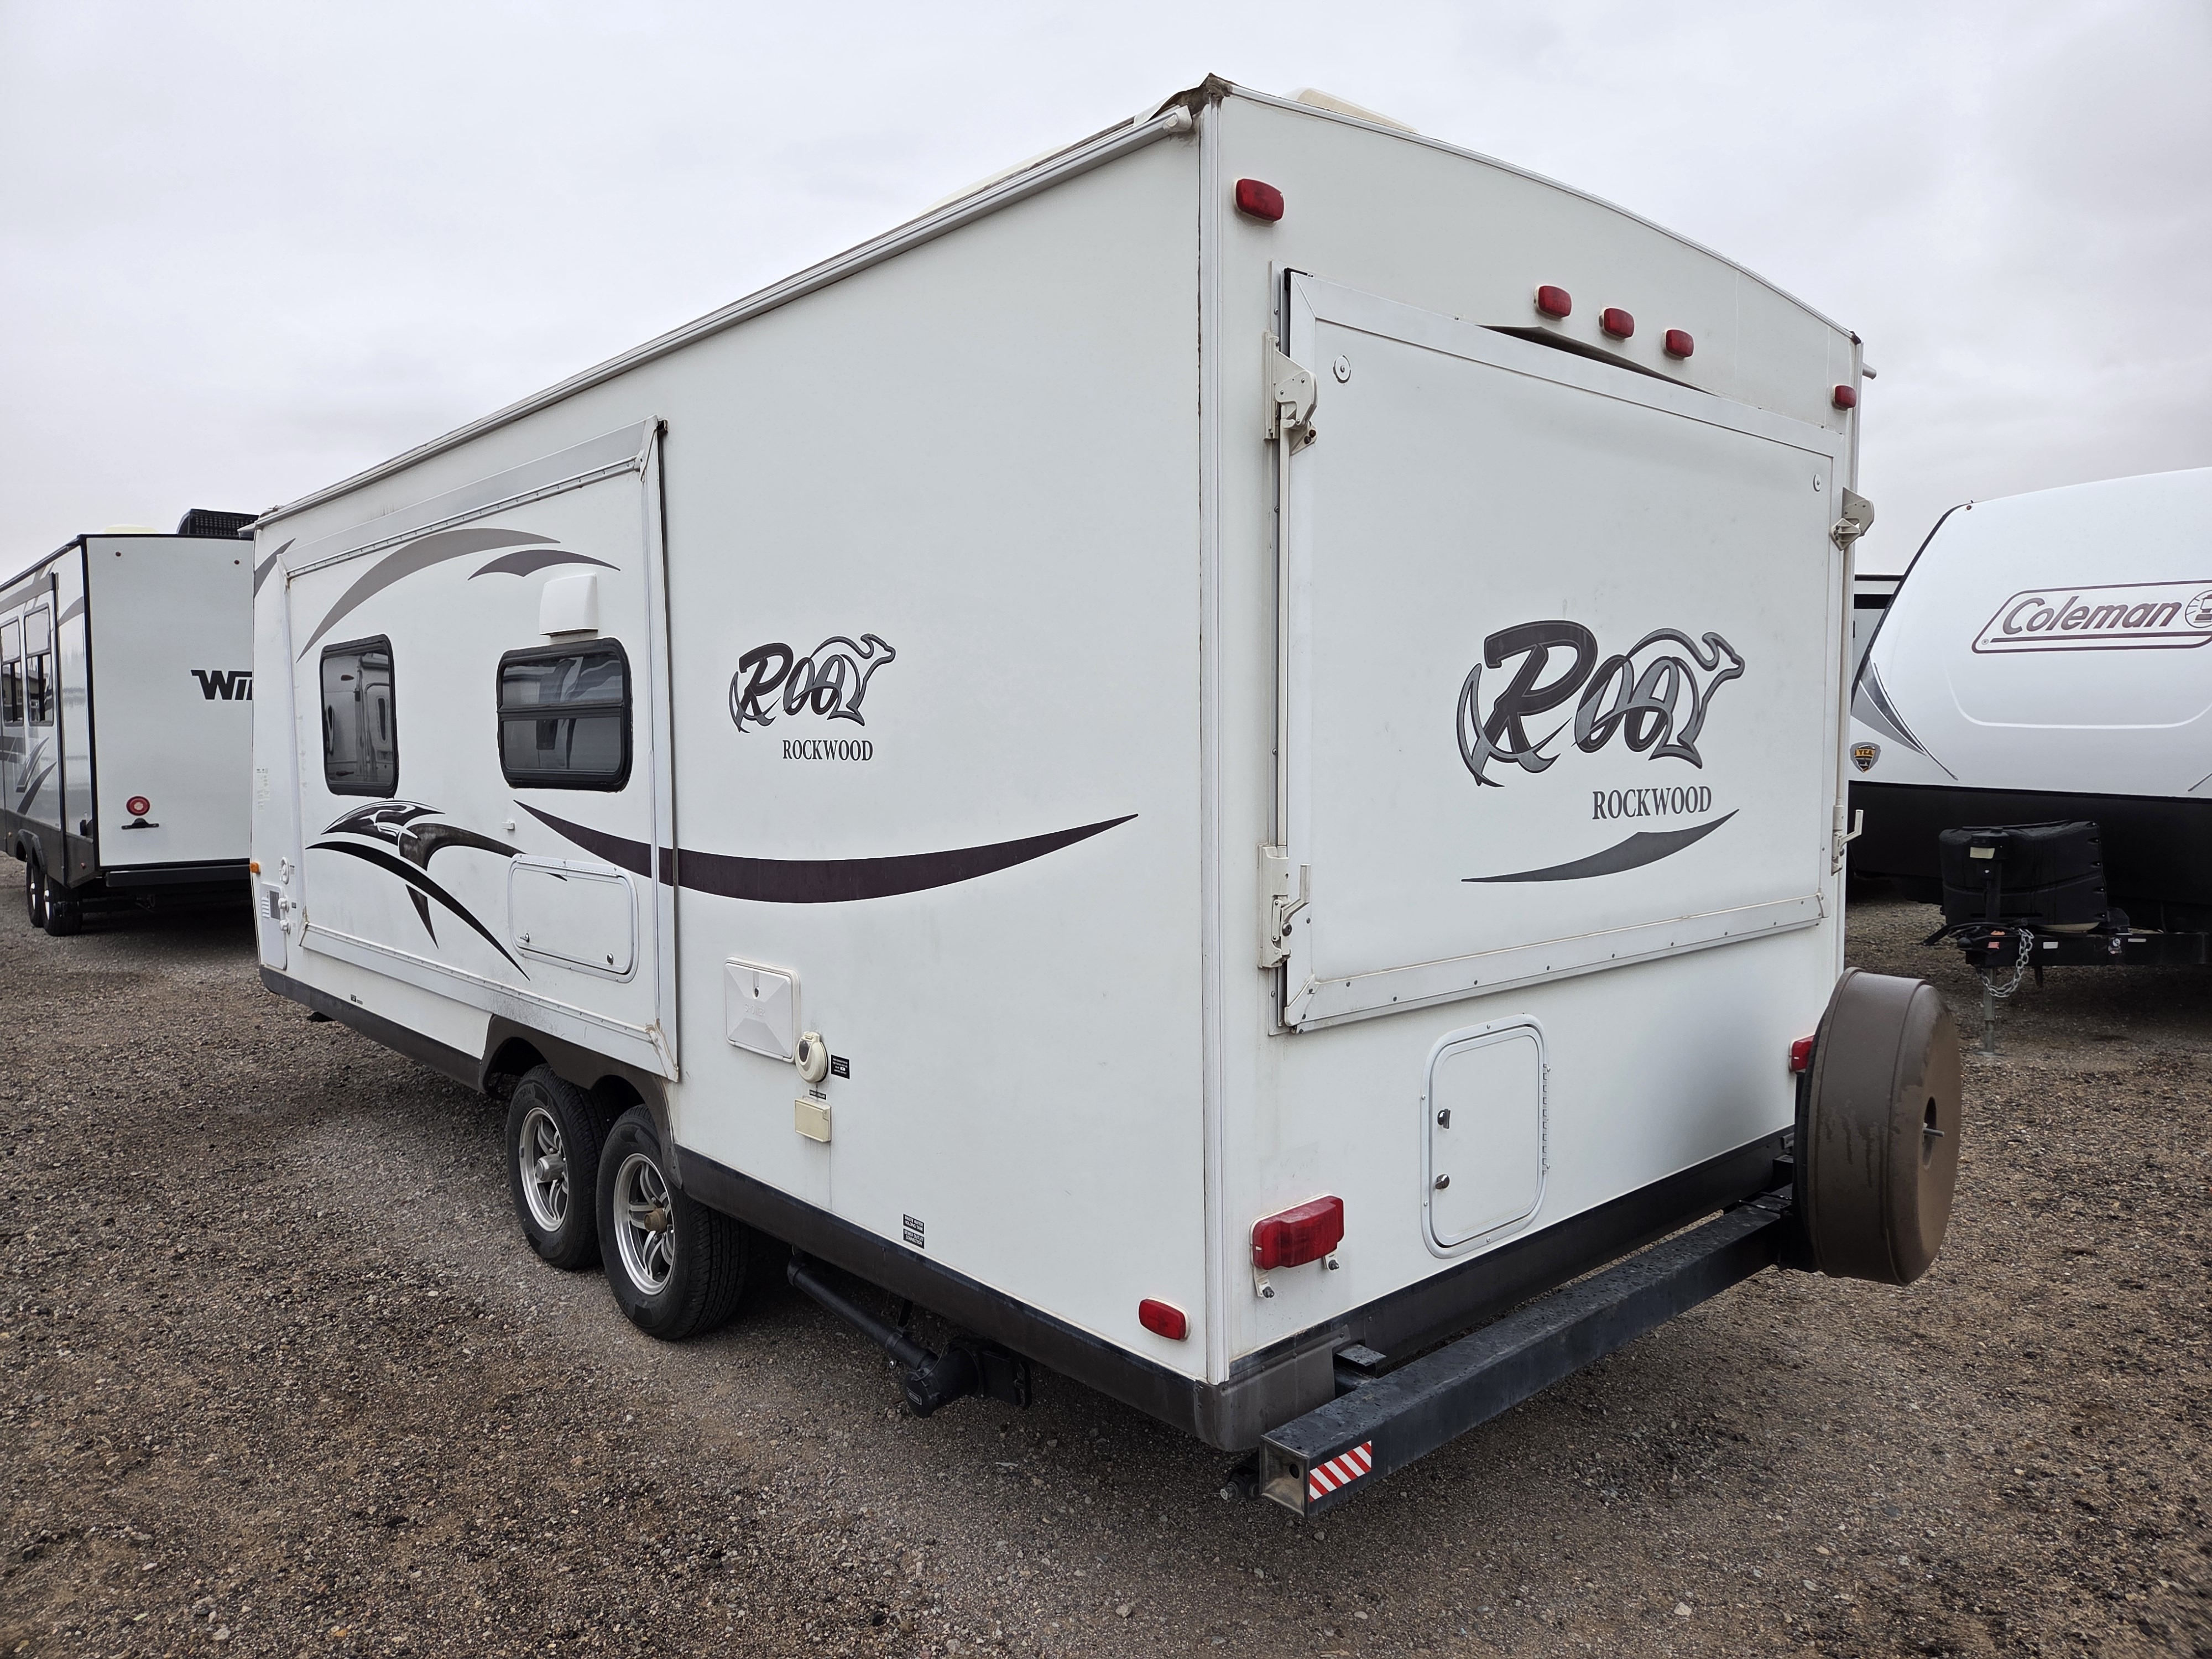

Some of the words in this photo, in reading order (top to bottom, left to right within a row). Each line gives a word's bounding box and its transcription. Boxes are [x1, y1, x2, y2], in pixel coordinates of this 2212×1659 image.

[2002, 595, 2183, 635] Coleman
[782, 739, 873, 761] ROCKWOOD
[1592, 786, 1712, 820] ROCKWOOD
